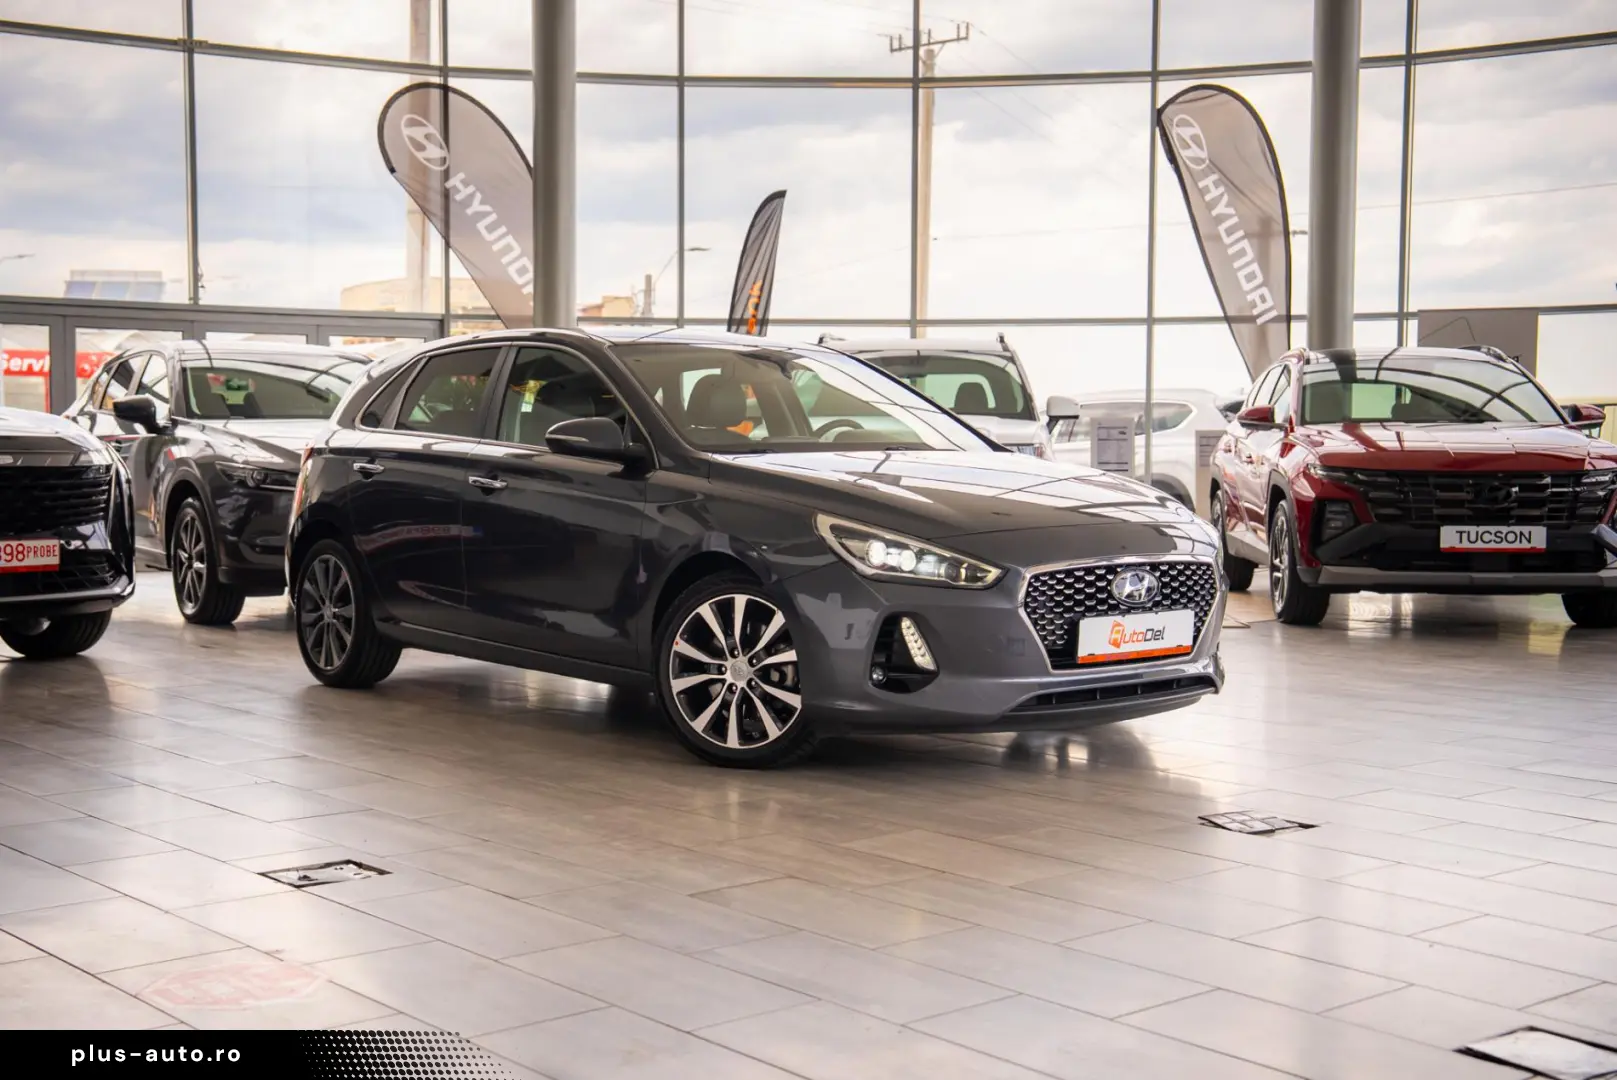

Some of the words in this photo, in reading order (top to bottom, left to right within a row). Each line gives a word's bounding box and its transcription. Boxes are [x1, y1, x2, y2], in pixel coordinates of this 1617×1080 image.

[444, 172, 534, 304] HYUND
[1198, 173, 1278, 326] HYUNDAI
[0, 353, 50, 373] Servi
[1455, 530, 1532, 545] TUCSON
[0, 543, 26, 563] 98
[26, 544, 58, 559] PROBE
[1108, 620, 1166, 649] AutoDel
